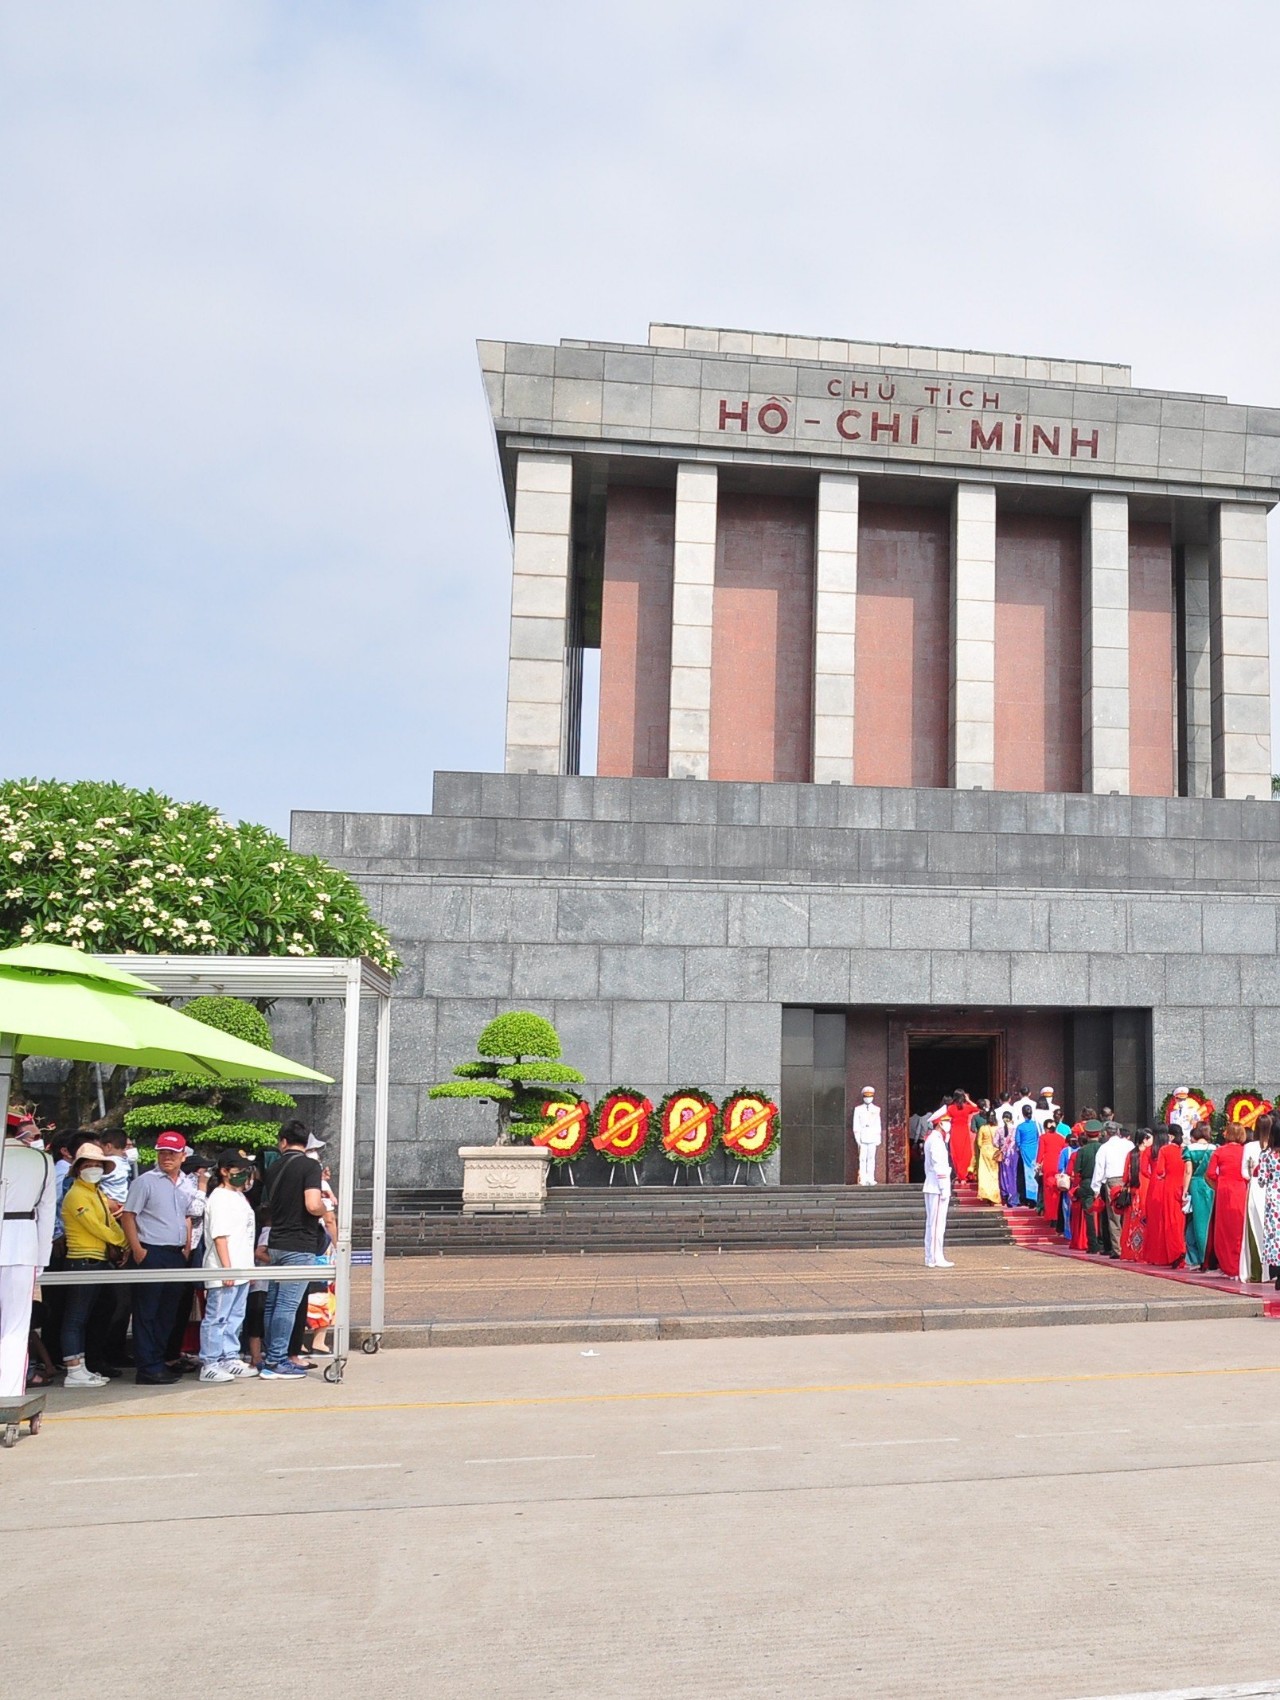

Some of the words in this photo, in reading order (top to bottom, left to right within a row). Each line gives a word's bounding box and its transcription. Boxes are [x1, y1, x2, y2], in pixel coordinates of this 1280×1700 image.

[827, 376, 896, 401] CHỦ
[924, 382, 1000, 414] TỊCH
[718, 396, 793, 435] HỒ
[836, 407, 925, 446] CHÍ
